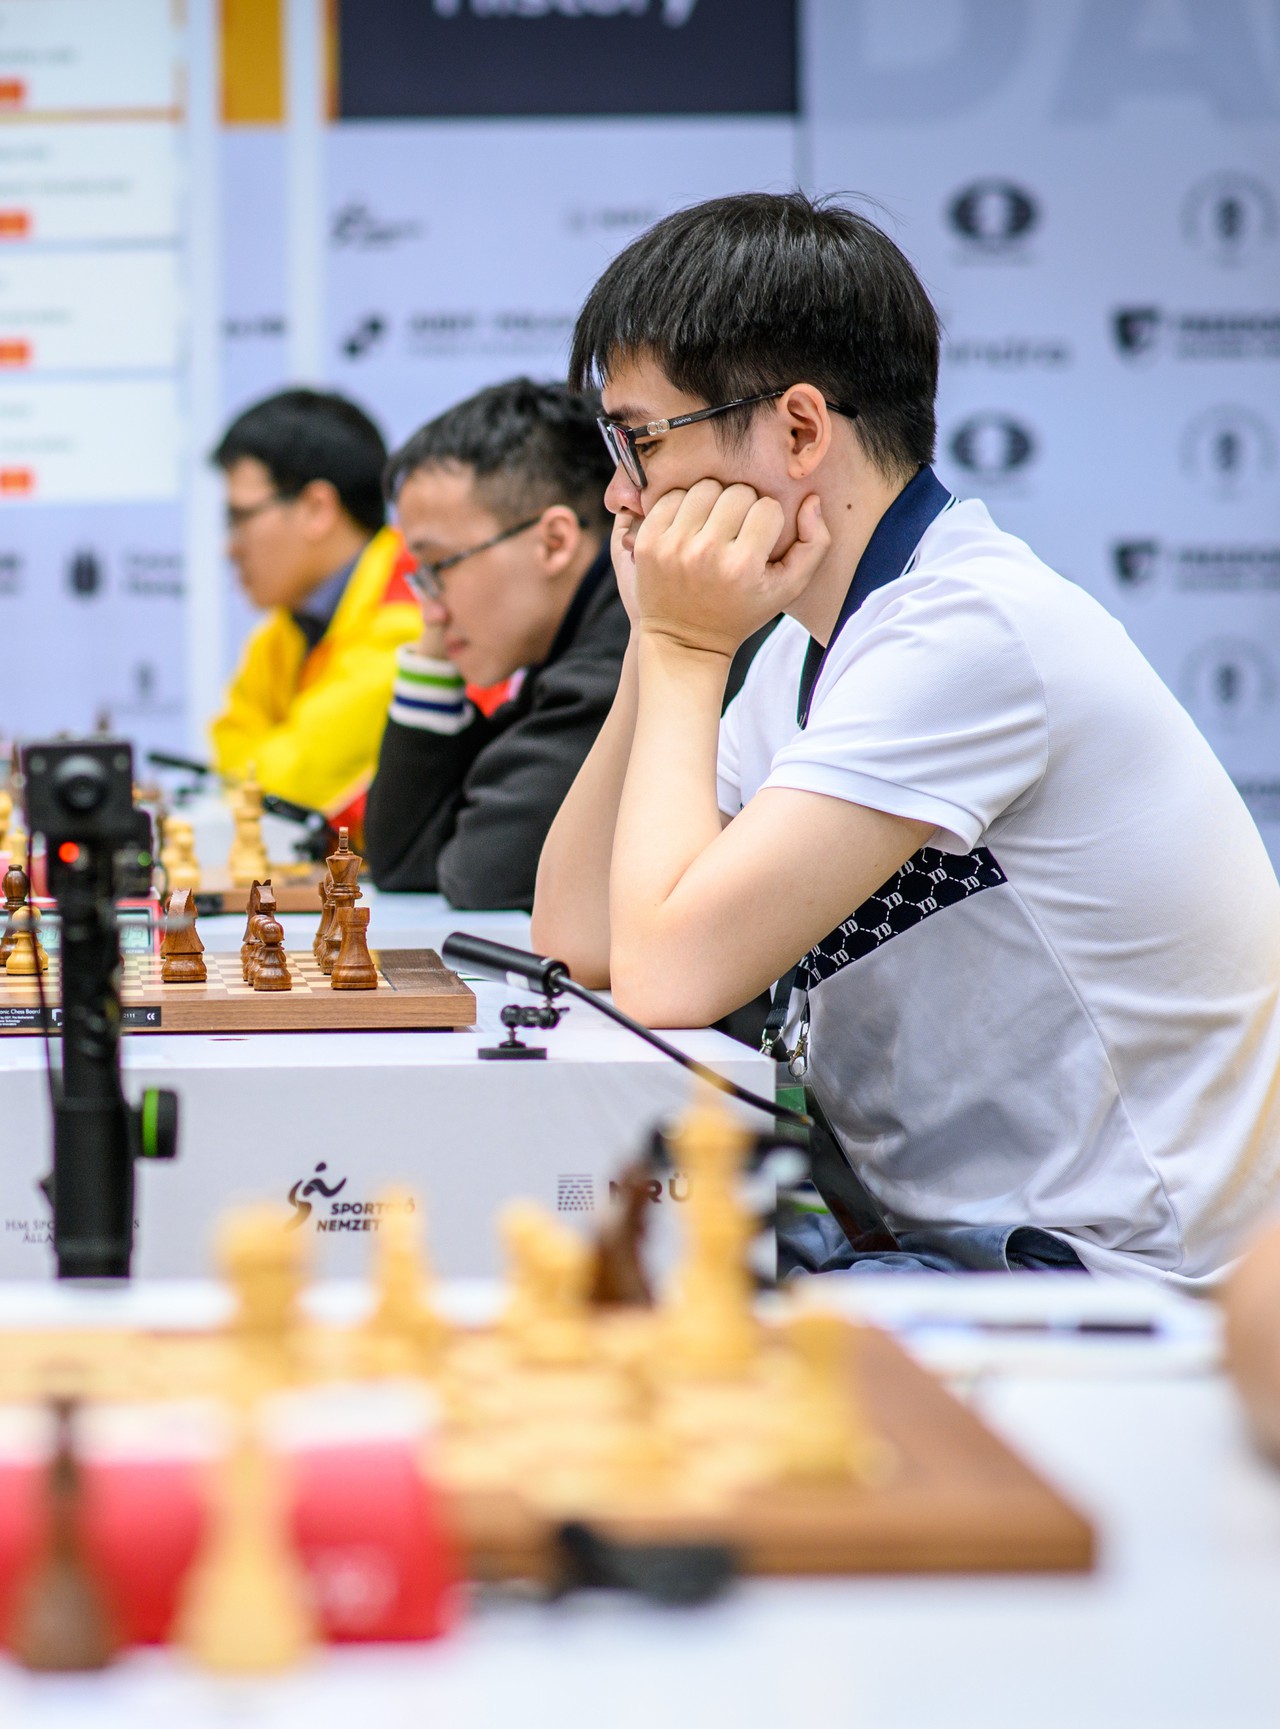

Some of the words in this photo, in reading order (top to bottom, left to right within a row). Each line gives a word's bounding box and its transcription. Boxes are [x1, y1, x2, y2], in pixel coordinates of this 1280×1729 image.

[927, 867, 948, 885] YD
[960, 874, 981, 892] YD
[882, 891, 904, 910] YD
[917, 896, 938, 915] YD
[838, 918, 859, 937] YD
[871, 922, 892, 941] YD
[829, 948, 850, 967] YD
